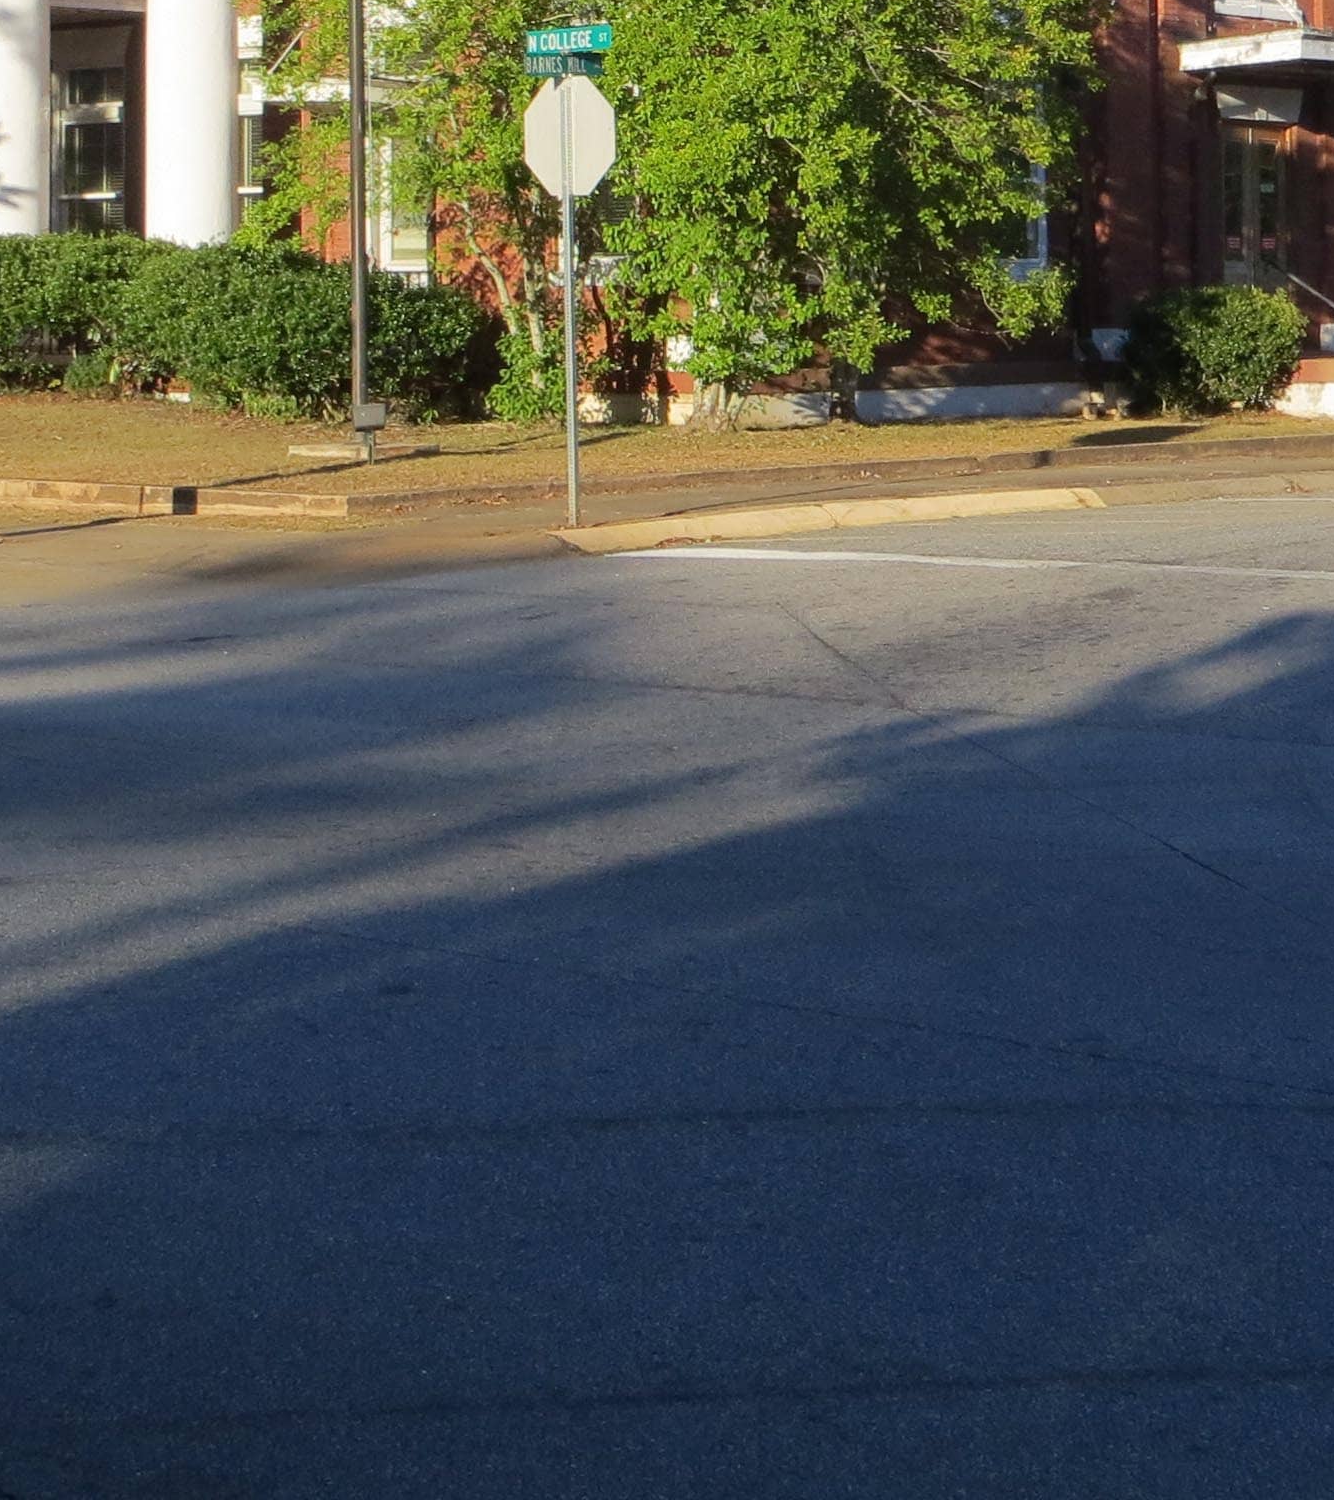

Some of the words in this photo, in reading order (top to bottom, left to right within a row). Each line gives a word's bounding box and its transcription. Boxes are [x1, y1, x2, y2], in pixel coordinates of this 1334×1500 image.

[529, 34, 537, 52] N
[540, 30, 592, 51] COLLEGE
[598, 32, 607, 42] ST
[526, 56, 563, 74] BARNES
